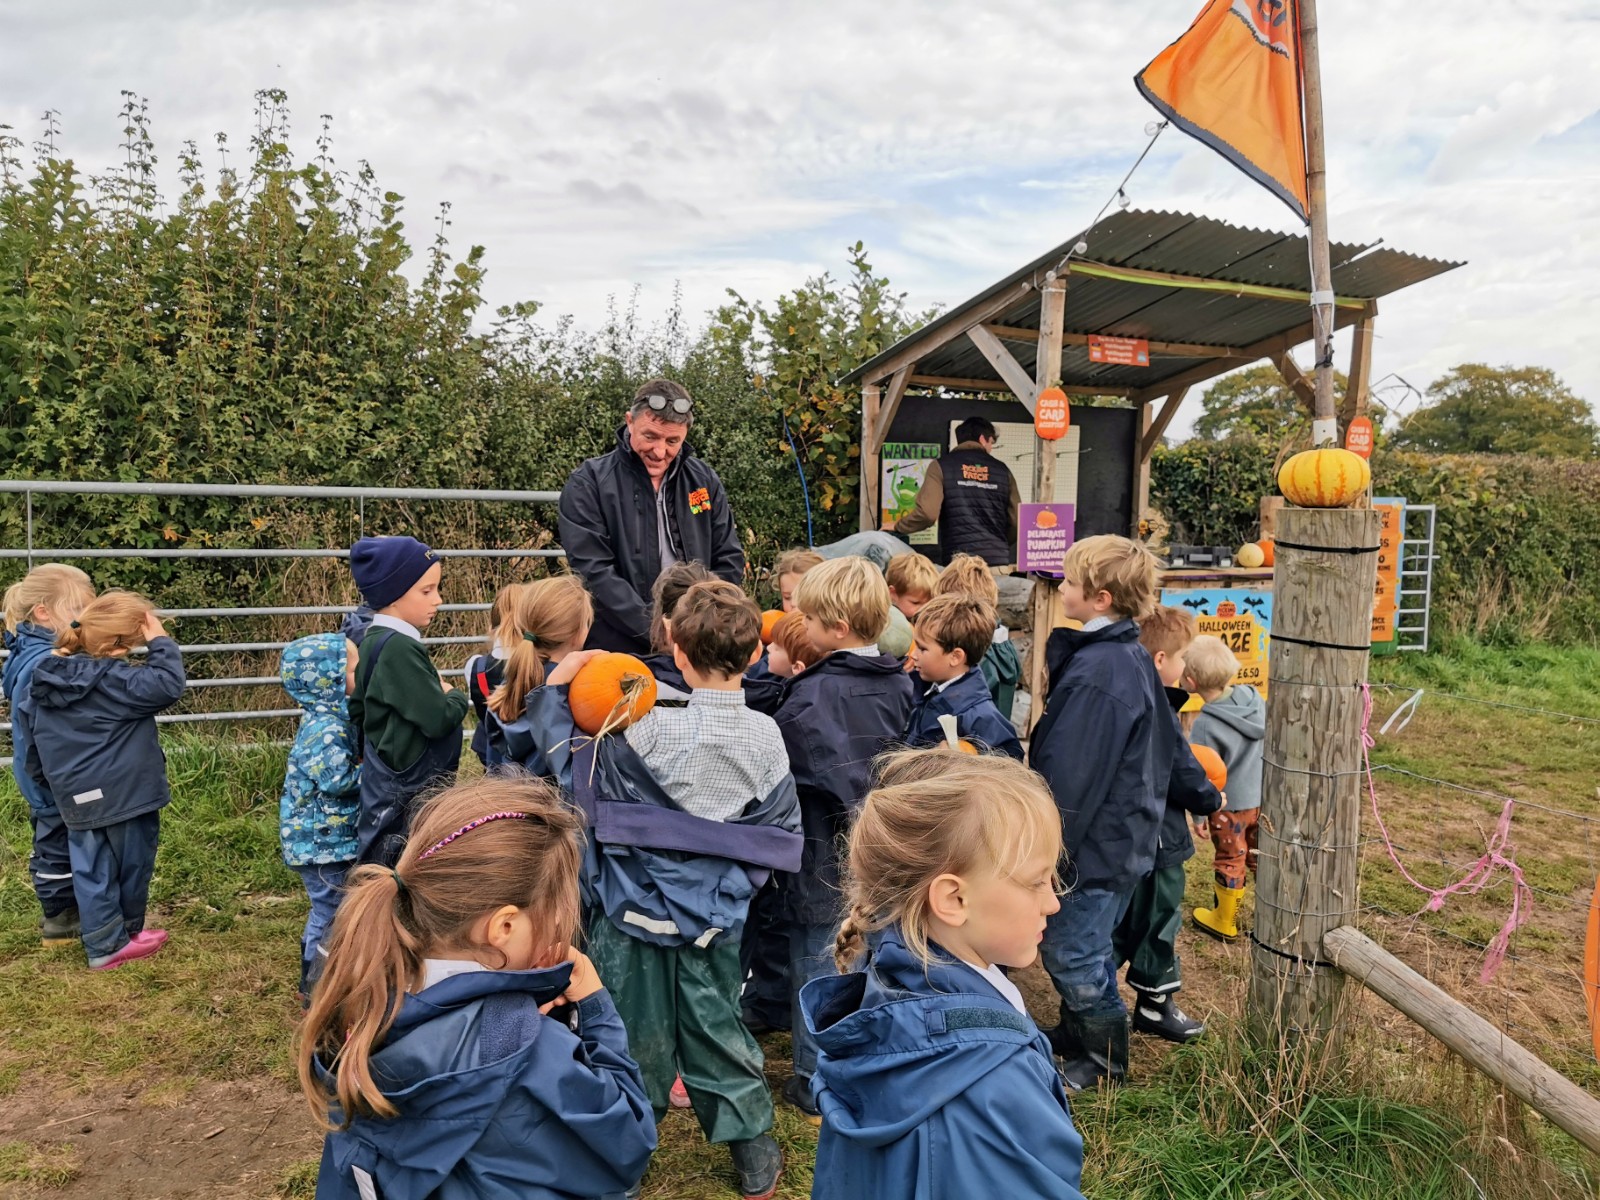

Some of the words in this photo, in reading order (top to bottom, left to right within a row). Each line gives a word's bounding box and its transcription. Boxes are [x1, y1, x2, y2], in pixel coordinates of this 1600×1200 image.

[1039, 408, 1065, 421] CARD
[1350, 434, 1369, 445] CARD
[883, 444, 940, 460] WANTED
[963, 471, 990, 481] PATCH
[1027, 529, 1066, 538] DELIBERATE
[1027, 539, 1066, 550] PUMPKIN
[1199, 621, 1251, 632] HALLOWEEN
[1237, 667, 1259, 678] £6.50
